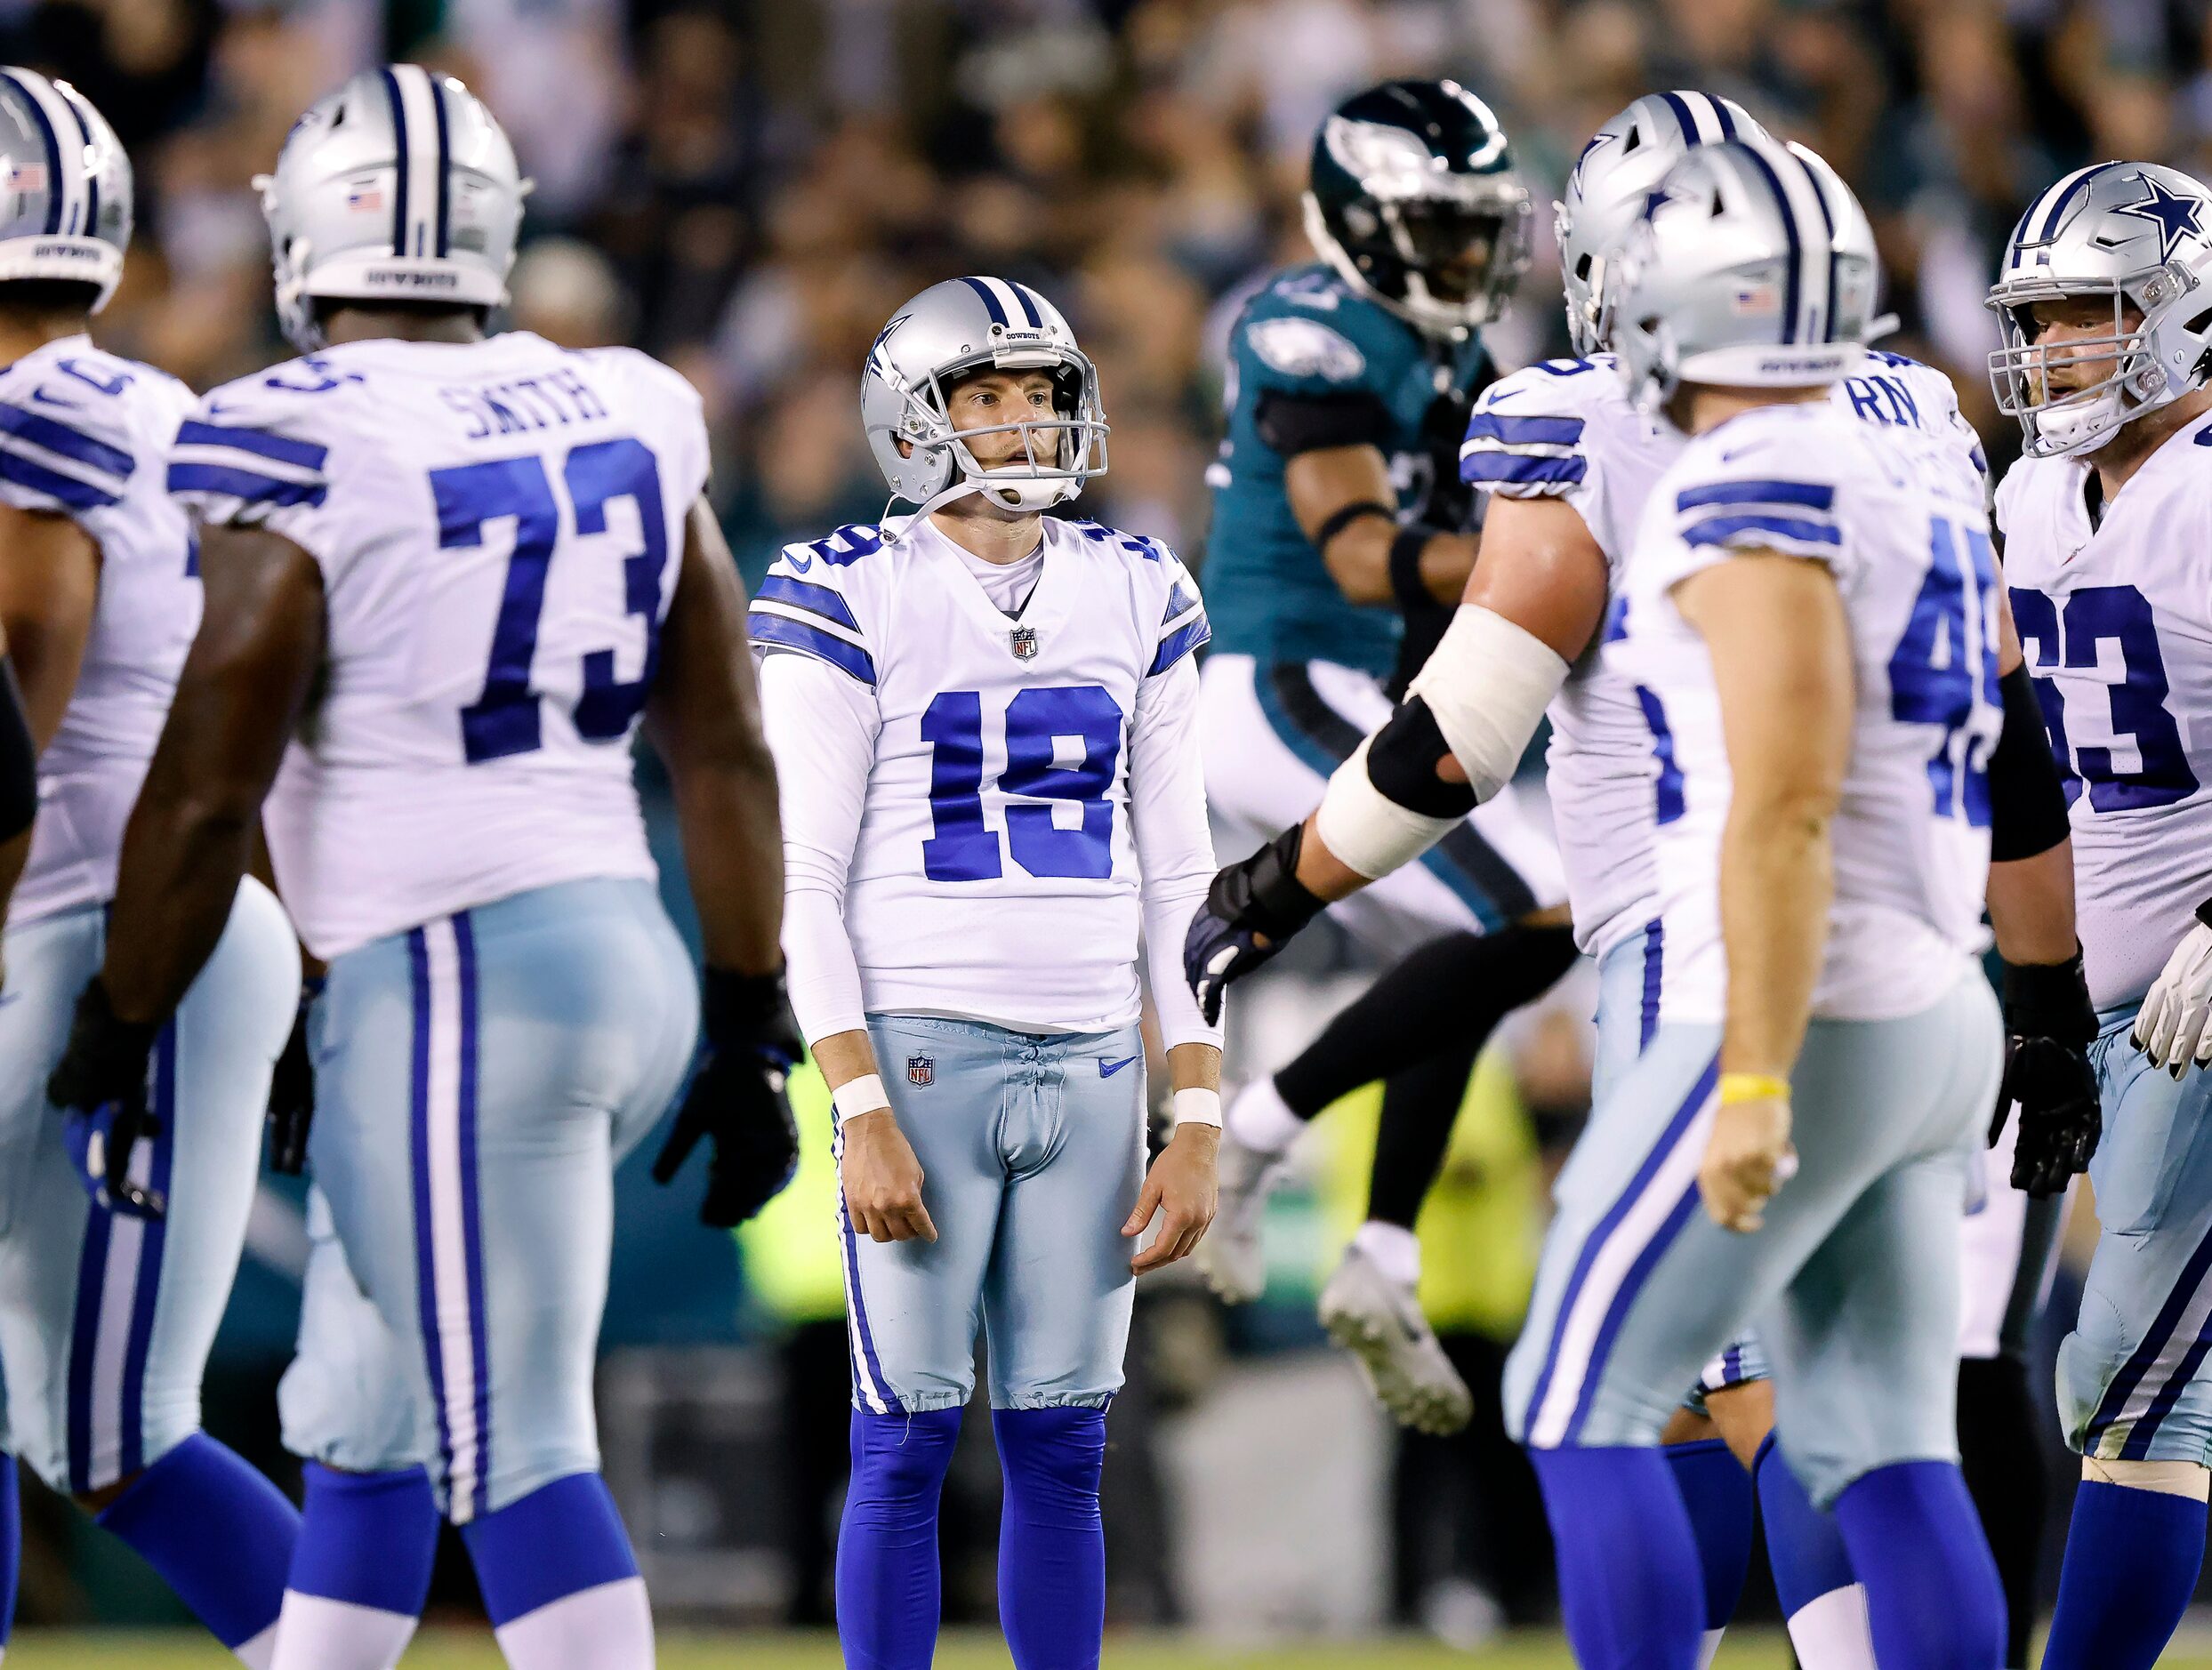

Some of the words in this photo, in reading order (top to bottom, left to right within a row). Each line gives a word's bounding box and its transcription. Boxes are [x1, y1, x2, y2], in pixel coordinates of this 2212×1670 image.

[1006, 332, 1041, 340] COWBOYS
[440, 367, 608, 438] SMITH
[1843, 375, 1920, 429] RN
[429, 438, 668, 766] 73
[1015, 640, 1035, 655] NFL
[2009, 584, 2200, 814] 63
[921, 685, 1124, 882] 19
[910, 1068, 931, 1082] NFL
